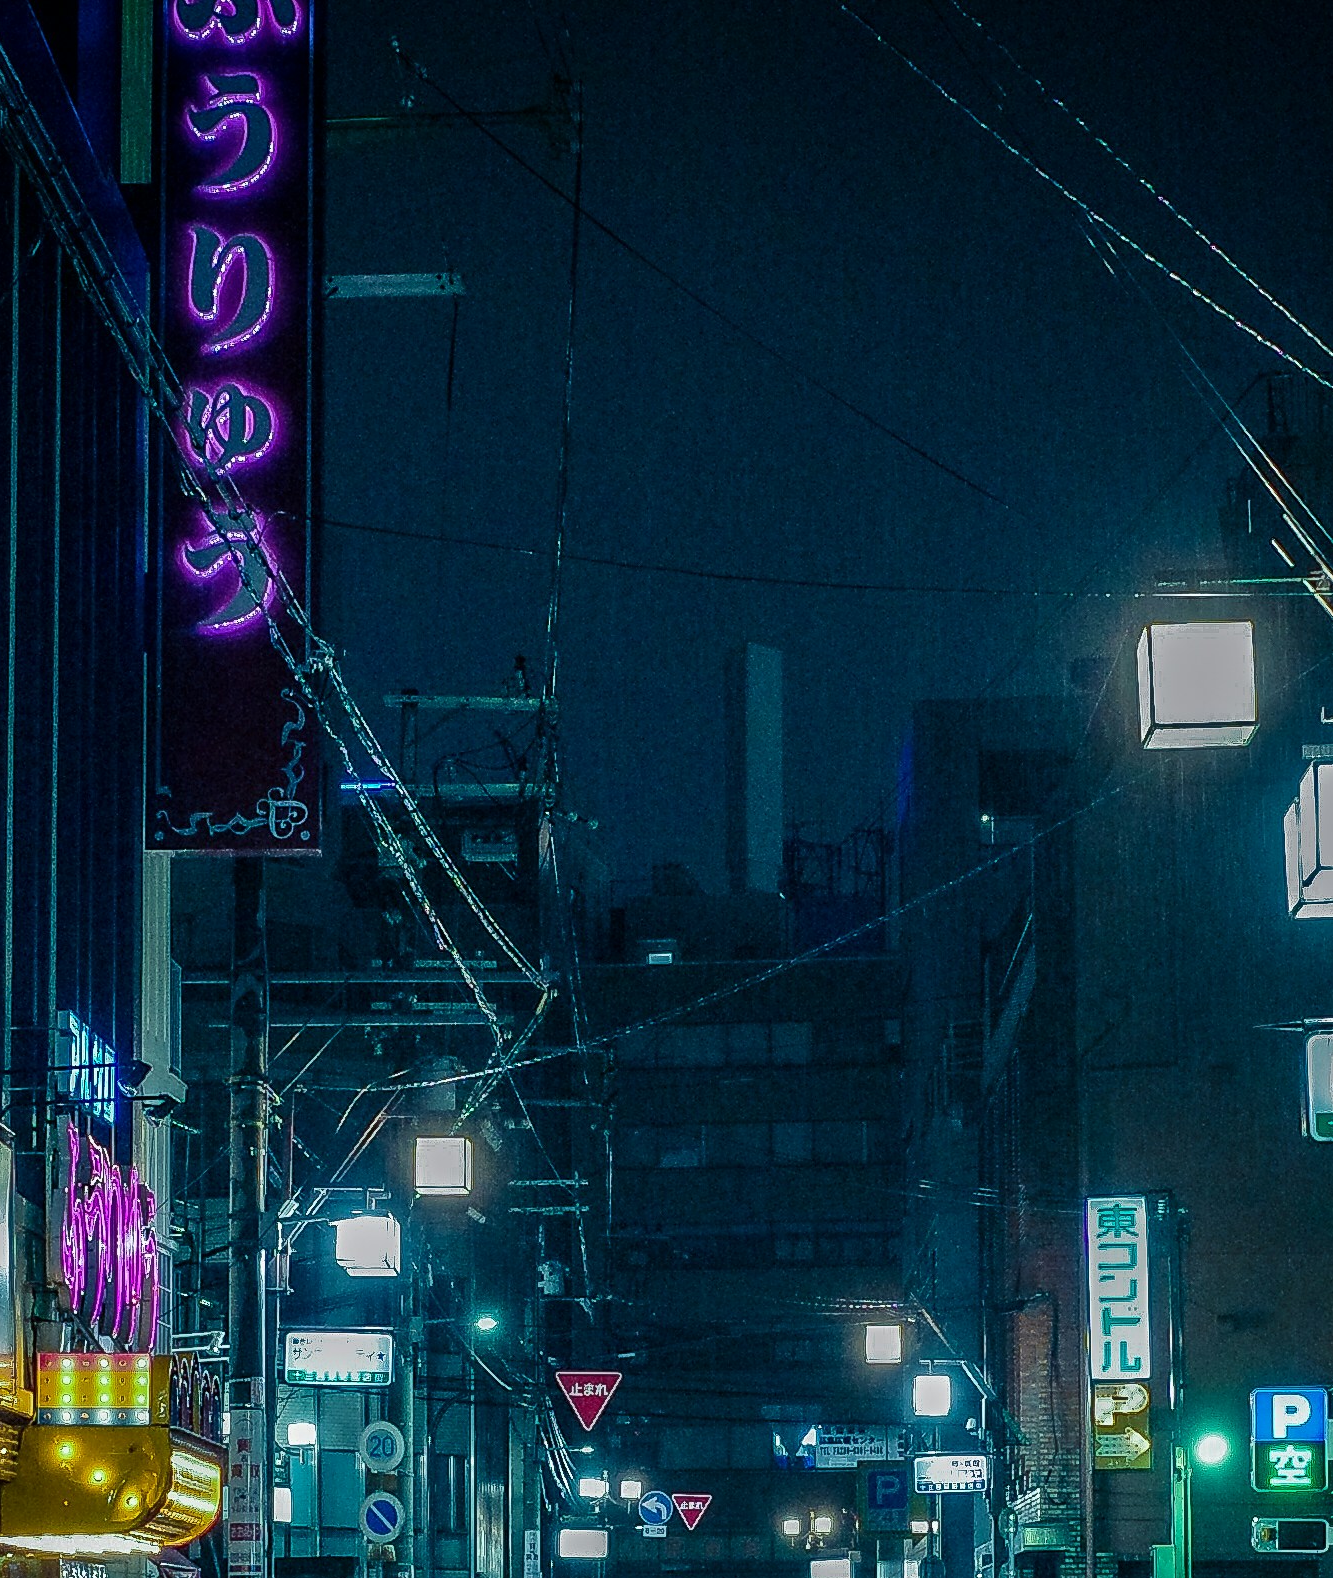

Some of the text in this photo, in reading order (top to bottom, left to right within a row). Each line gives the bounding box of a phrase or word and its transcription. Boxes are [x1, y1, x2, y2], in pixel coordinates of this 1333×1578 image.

[569, 1383, 609, 1397] 止まれ
[1272, 1394, 1312, 1439] P
[370, 1436, 395, 1458] 20
[1269, 1445, 1312, 1486] 空
[876, 1476, 900, 1504] P
